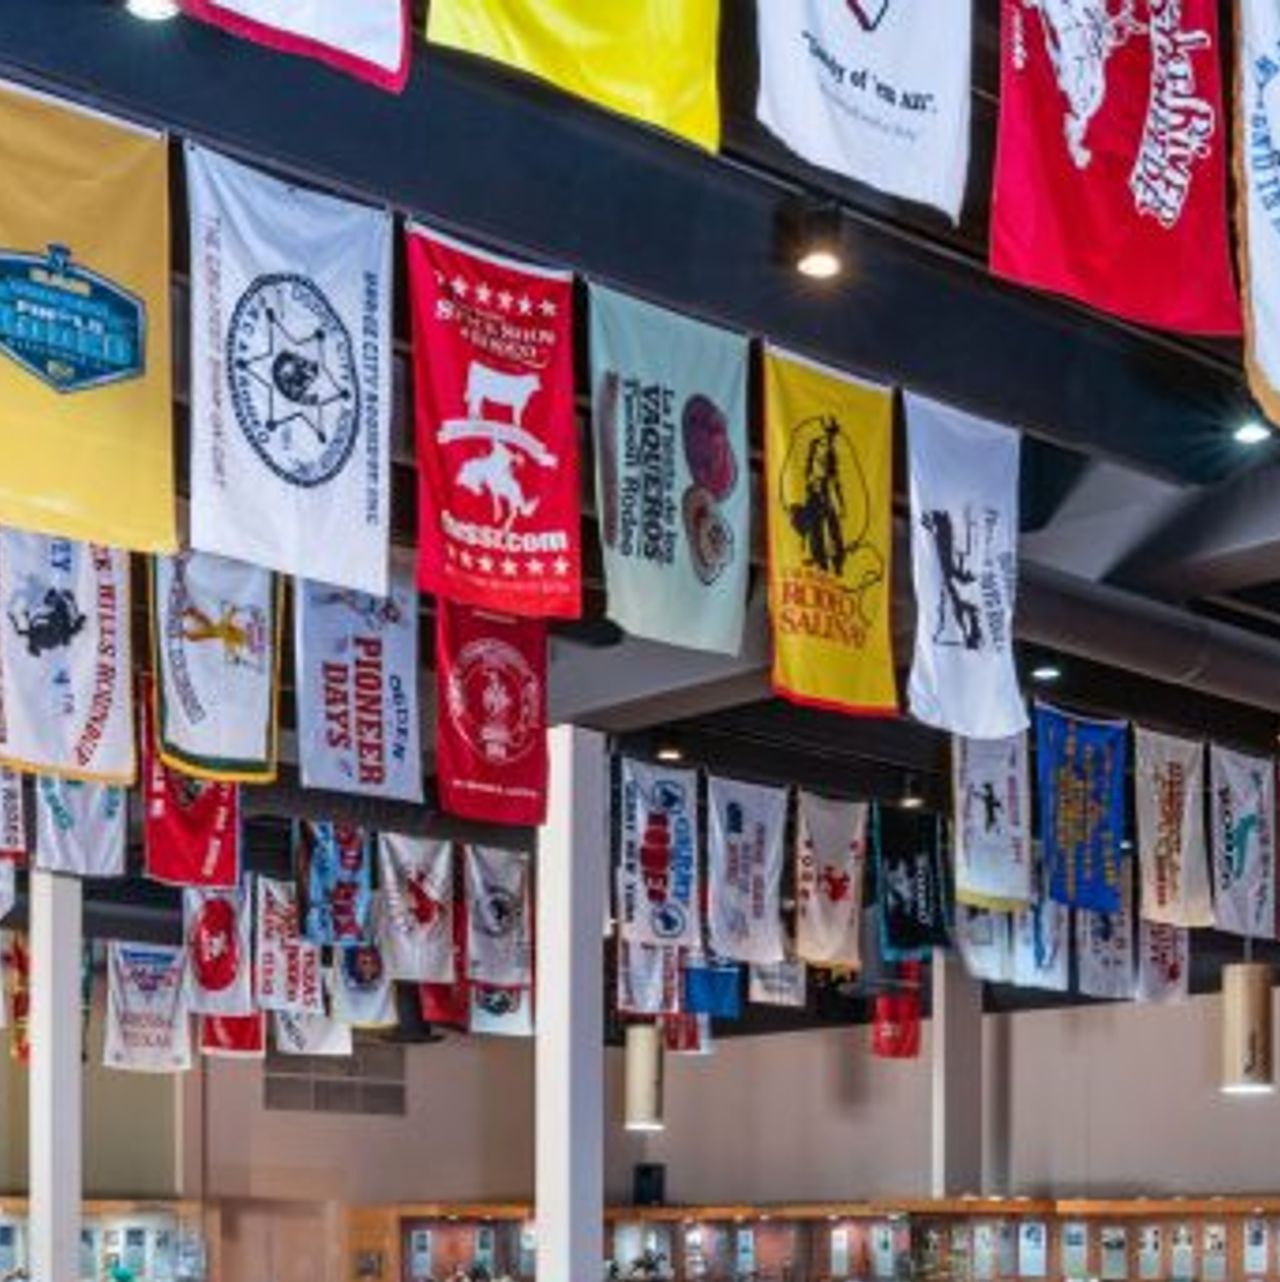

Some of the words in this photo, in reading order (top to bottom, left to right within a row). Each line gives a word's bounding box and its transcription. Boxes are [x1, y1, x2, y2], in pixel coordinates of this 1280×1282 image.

[361, 341, 380, 386] CITY
[620, 476, 640, 557] Rodeo
[641, 384, 666, 561] VAQUEROS
[97, 583, 117, 656] HILLS
[322, 661, 352, 751] DAYS
[353, 635, 385, 787] PIONEER
[388, 674, 410, 762] OGDEN
